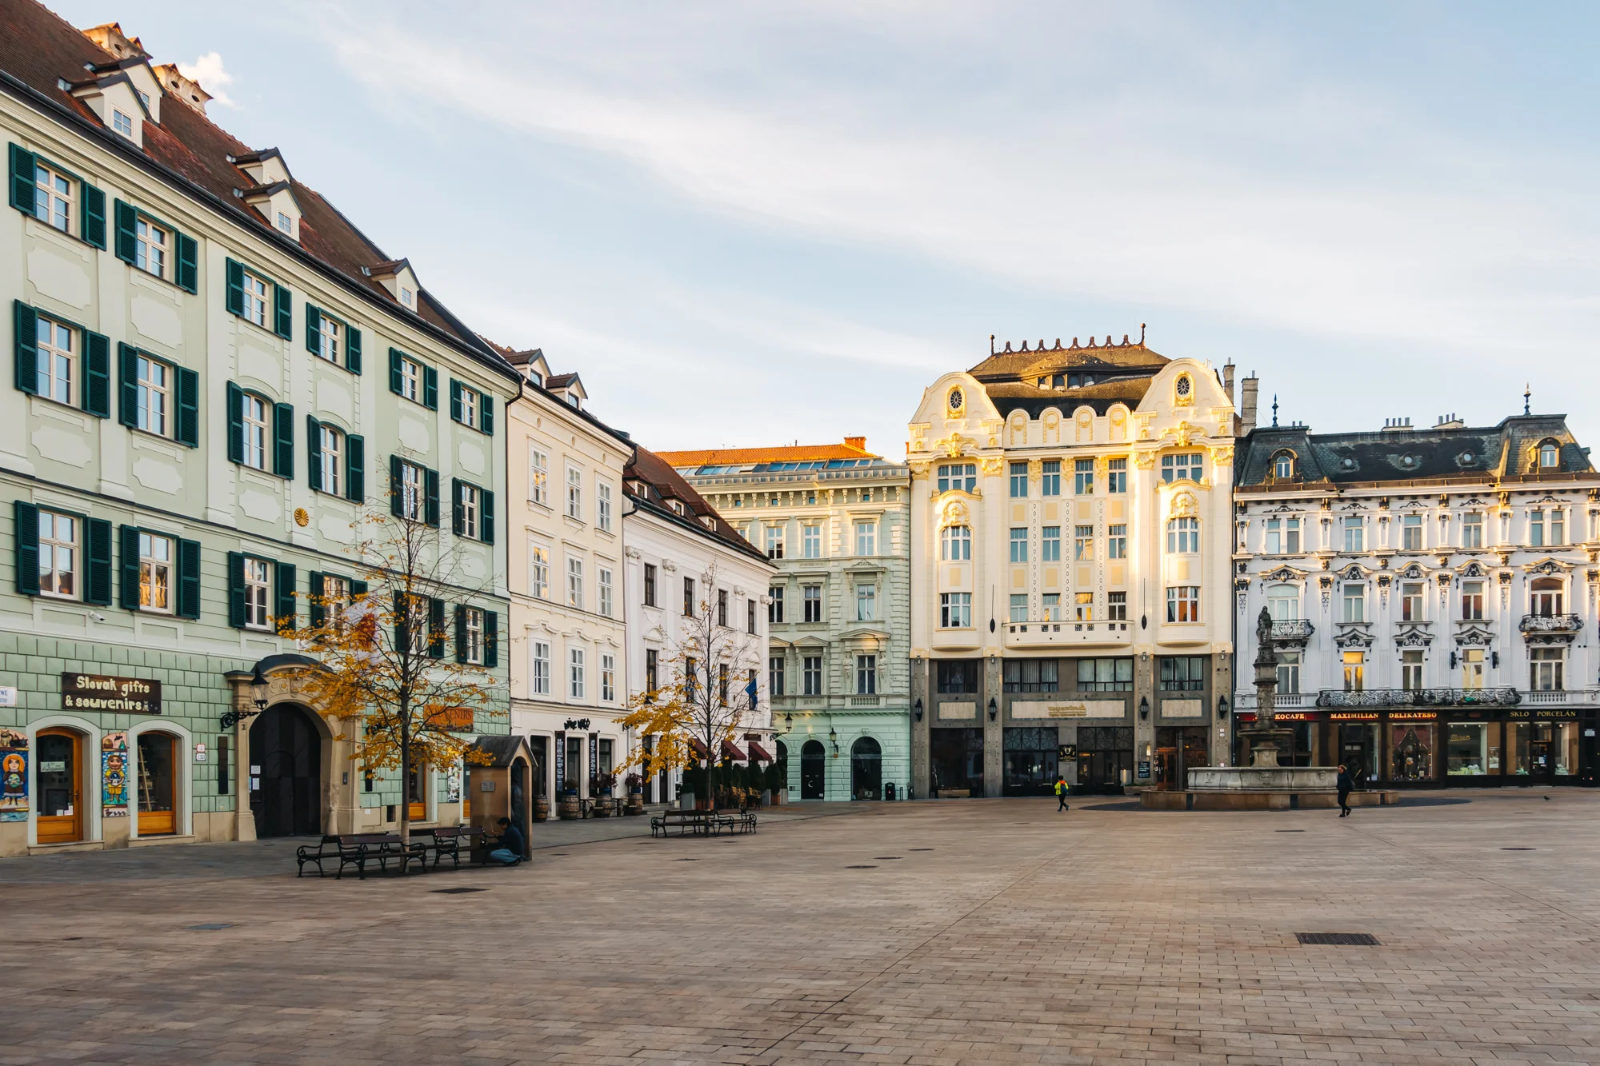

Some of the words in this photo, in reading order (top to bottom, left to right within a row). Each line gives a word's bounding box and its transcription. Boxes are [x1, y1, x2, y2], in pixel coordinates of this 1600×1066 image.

[76, 675, 117, 691] Slovak
[121, 681, 150, 697] gifts
[65, 695, 73, 706] &
[76, 697, 142, 710] souvenirs
